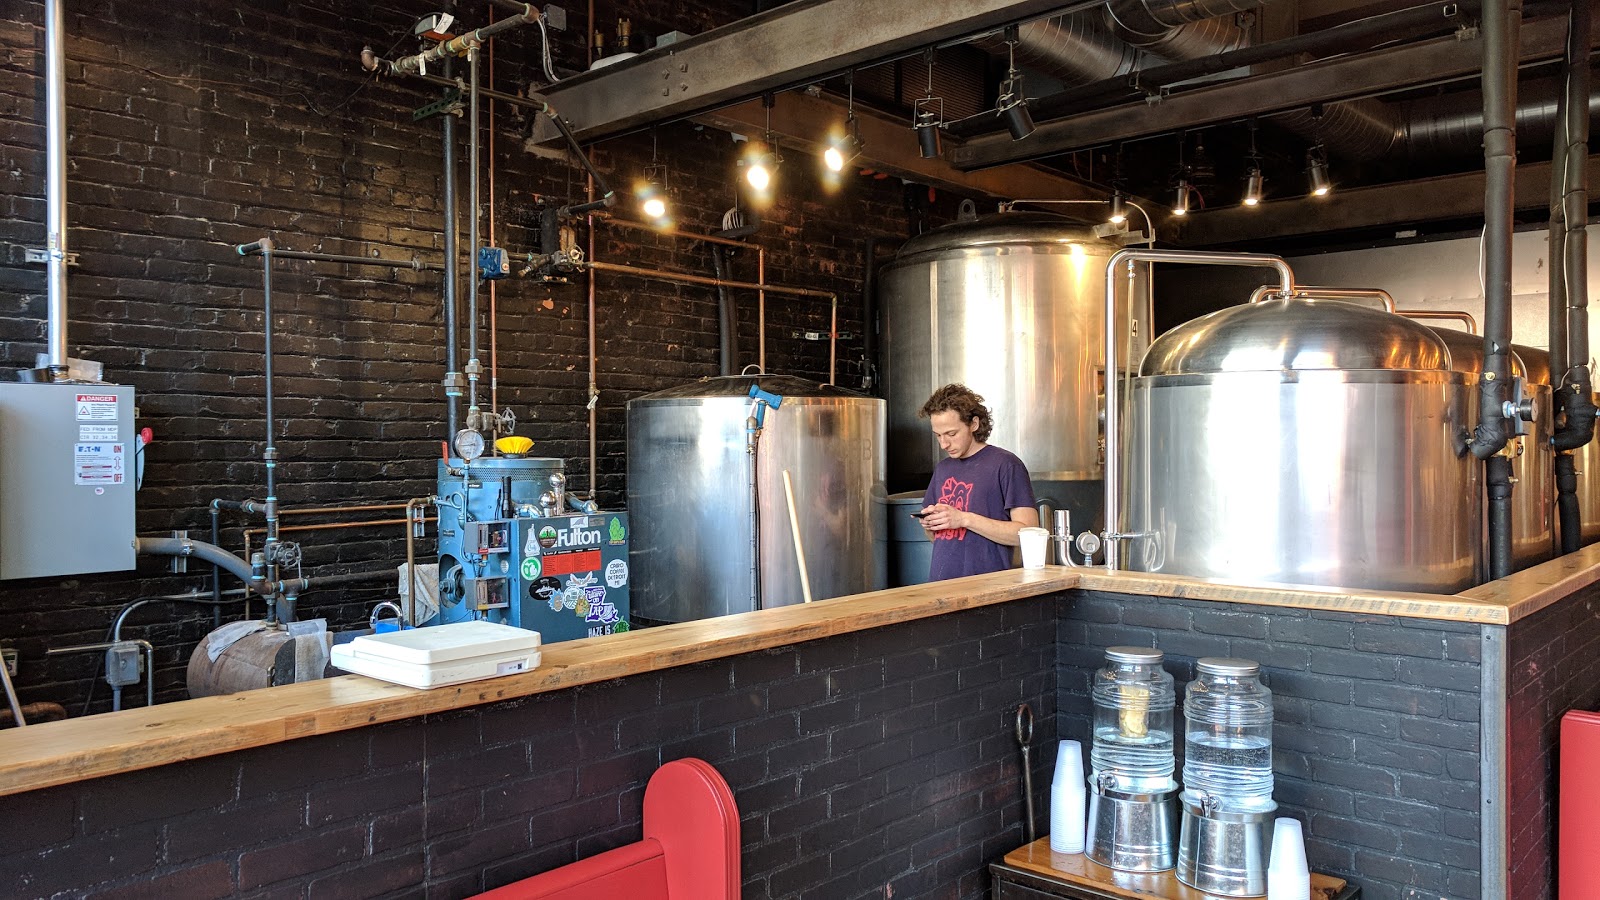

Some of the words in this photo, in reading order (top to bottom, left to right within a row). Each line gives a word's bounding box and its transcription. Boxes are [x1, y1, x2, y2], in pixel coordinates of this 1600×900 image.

[1132, 321, 1137, 336] 4
[114, 445, 122, 453] ON
[114, 473, 122, 483] OFF
[558, 528, 601, 547] Fulton
[588, 626, 603, 638] HAZE
[604, 625, 611, 635] IS
